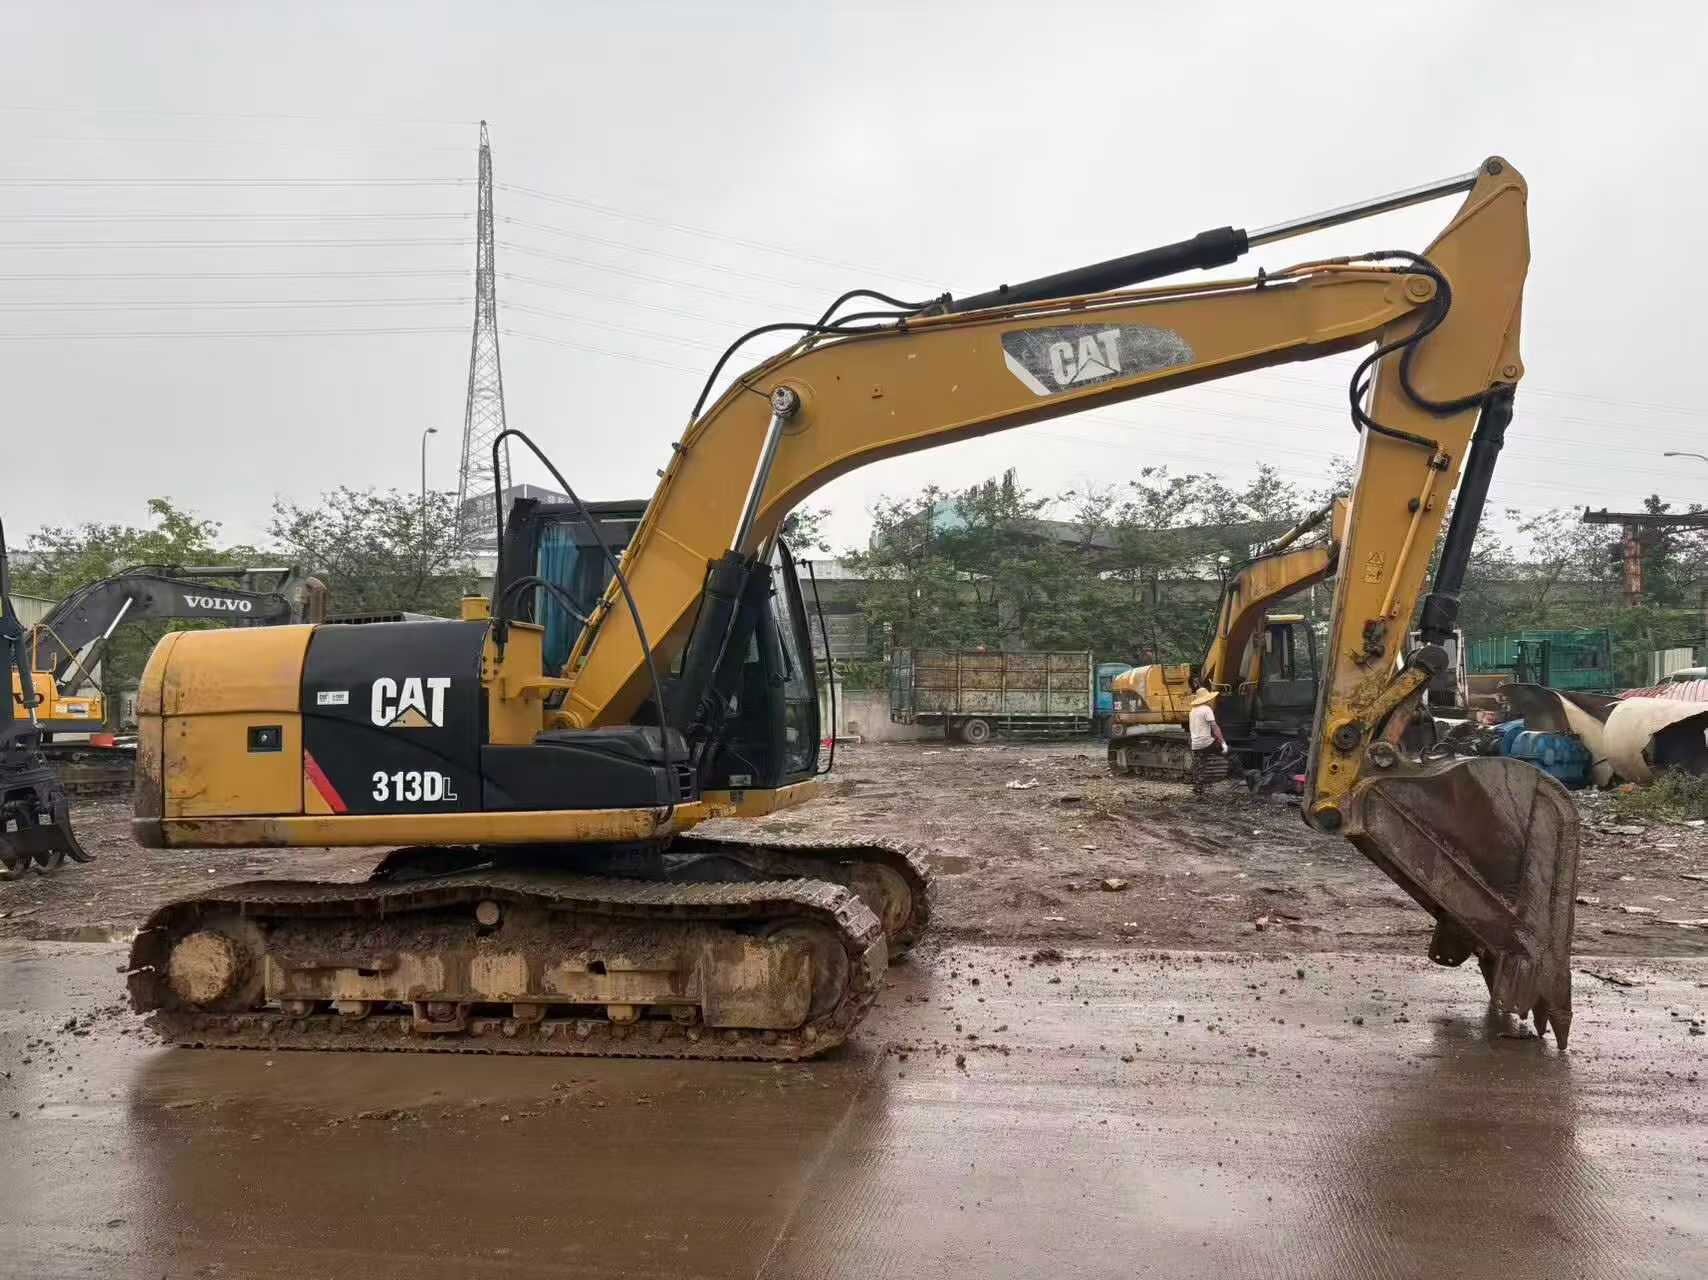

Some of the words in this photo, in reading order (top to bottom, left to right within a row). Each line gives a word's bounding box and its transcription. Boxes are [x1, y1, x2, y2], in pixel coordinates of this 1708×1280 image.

[1049, 328, 1121, 385] CAT
[183, 595, 252, 612] VOLVO
[371, 677, 451, 728] CAT
